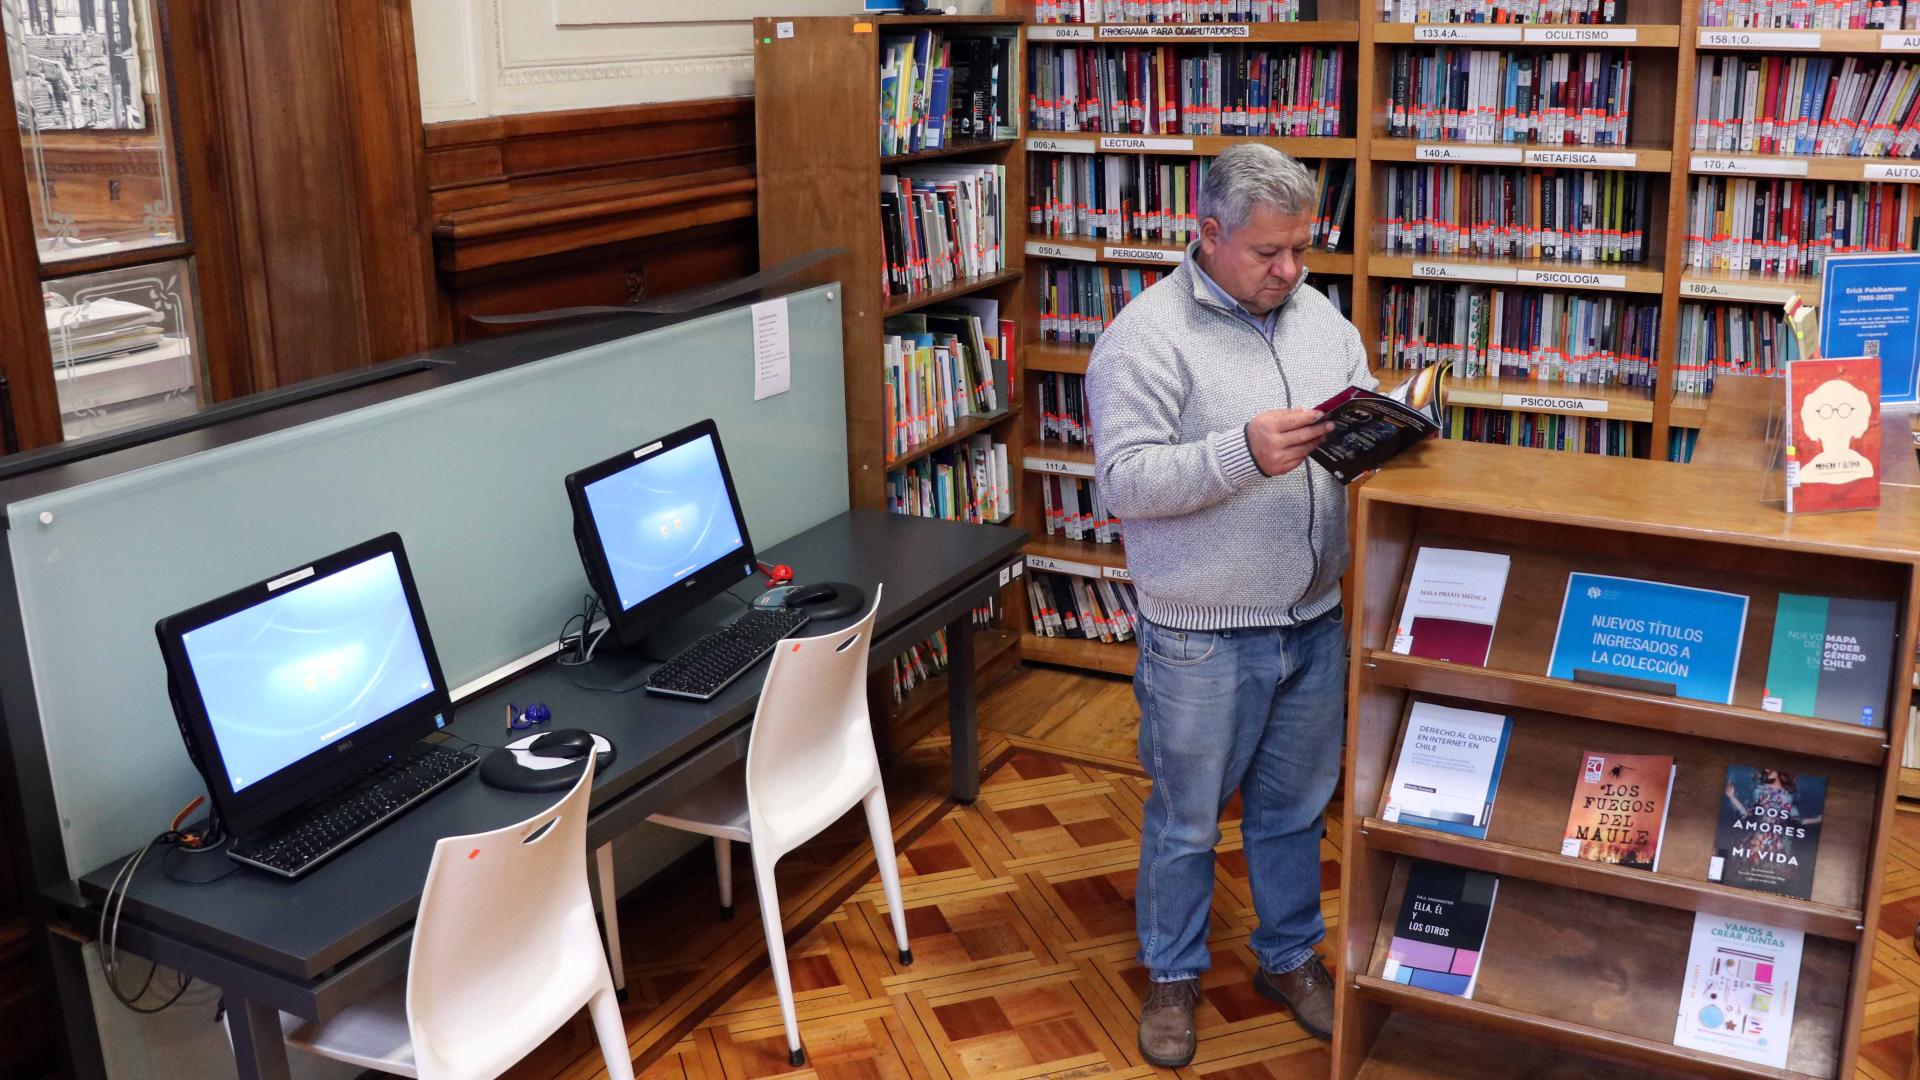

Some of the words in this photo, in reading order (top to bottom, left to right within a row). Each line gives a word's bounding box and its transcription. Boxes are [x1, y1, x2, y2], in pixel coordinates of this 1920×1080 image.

[1101, 26, 1148, 36] PROGRAMA
[1150, 26, 1173, 36] PARA
[1174, 26, 1246, 36] COMPUTADORES
[1546, 30, 1609, 40] OCULTISMO
[1104, 139, 1146, 148] LECTURA
[1533, 153, 1596, 164] METAFÍSICA
[1884, 168, 1920, 178] AUTO
[1112, 249, 1164, 260] PERIODISMO
[1536, 272, 1600, 284] PSICOLOGÍA
[1520, 397, 1584, 409] PSICOLOGÍA
[1592, 614, 1645, 632] NUEVOS
[1648, 620, 1703, 642] TÍTULOS
[1788, 630, 1823, 641] NUEVO
[1826, 634, 1857, 644] MAPA
[1593, 633, 1678, 656] INGRESADOS
[1680, 646, 1690, 660] A
[1804, 640, 1822, 648] DEL
[1824, 642, 1860, 653] PODER
[1592, 652, 1608, 664] LA
[1612, 653, 1688, 678] COLECCIÓN
[1822, 658, 1853, 669] CHILE
[1420, 725, 1456, 737] DERECHO
[1456, 731, 1467, 739] AL
[1468, 734, 1497, 743] OLVIDO
[1415, 742, 1437, 752] CHILE
[1430, 735, 1466, 747] INTERNET
[1604, 784, 1640, 797] LOS
[1583, 797, 1656, 812] FUEGOS
[1754, 806, 1789, 820] DOS
[1598, 814, 1634, 828] DEL
[1576, 825, 1650, 845] MAULE
[1732, 820, 1806, 838] AMORES
[1732, 847, 1751, 858] MI
[1758, 850, 1798, 866] VIDA
[1414, 902, 1432, 913] ELLA,
[1434, 904, 1443, 914] ÉL
[1412, 912, 1418, 920] Y
[1408, 922, 1424, 932] LOS
[1424, 924, 1450, 937] OTROS
[1724, 922, 1762, 936] VAMOS
[1766, 928, 1774, 938] A
[1711, 928, 1743, 940] CREAR
[1745, 934, 1785, 948] JUNTAS
